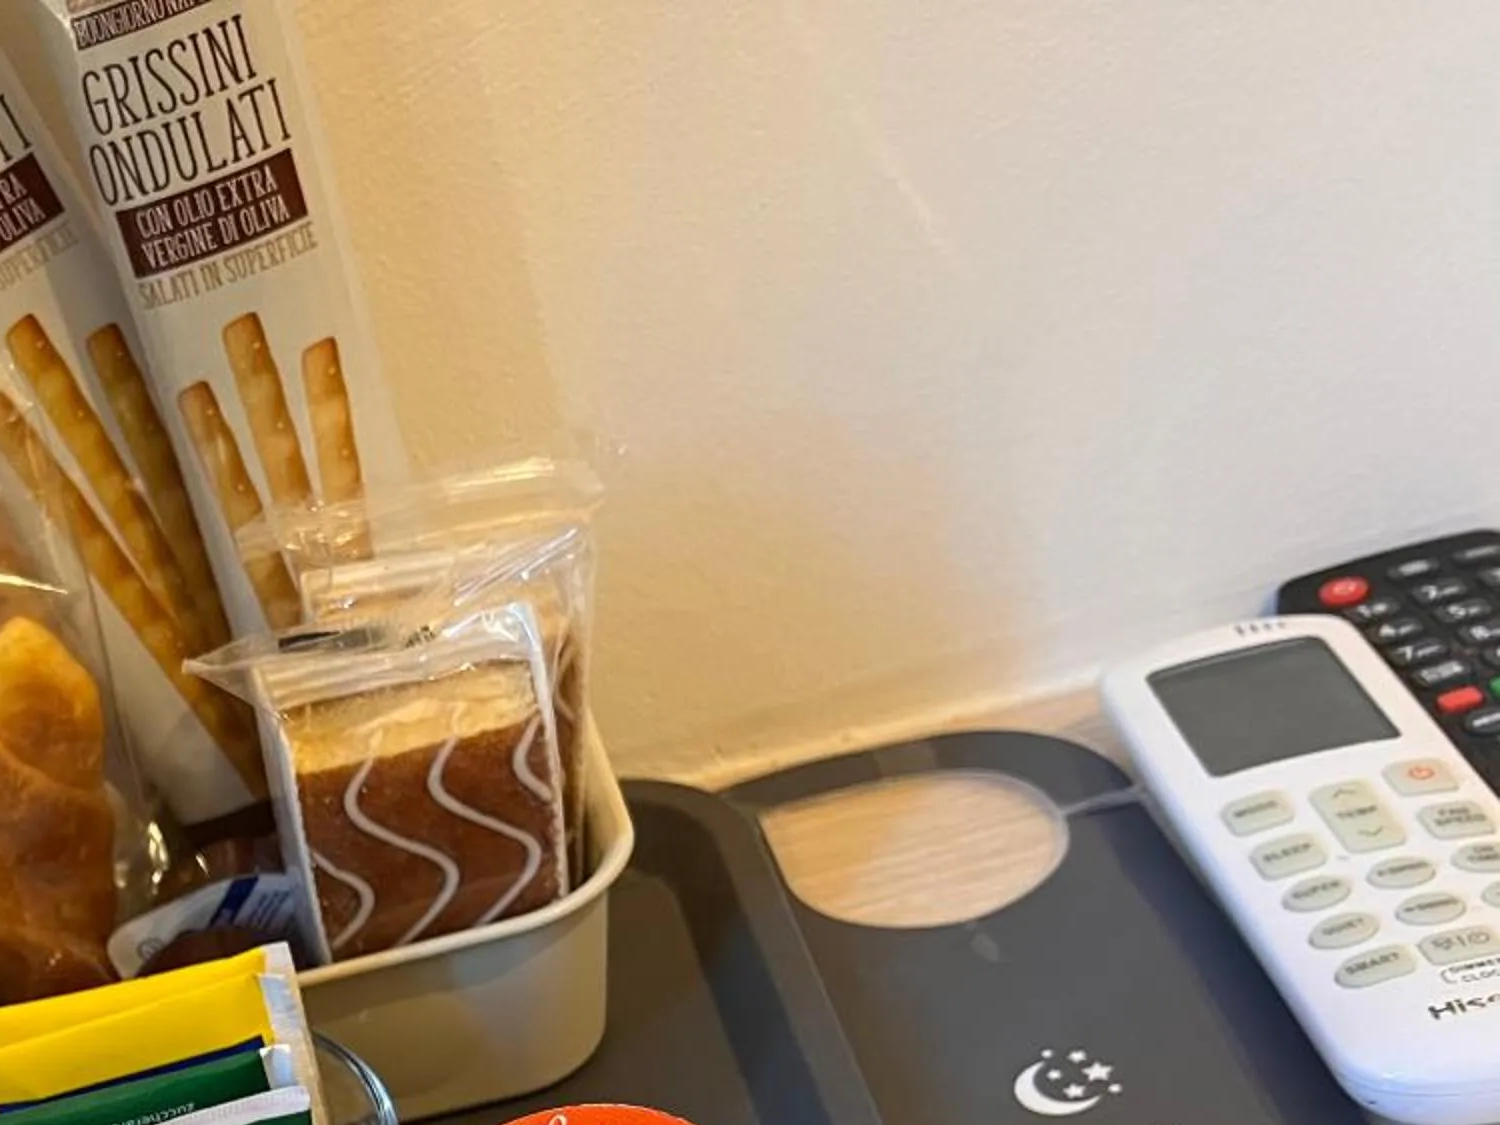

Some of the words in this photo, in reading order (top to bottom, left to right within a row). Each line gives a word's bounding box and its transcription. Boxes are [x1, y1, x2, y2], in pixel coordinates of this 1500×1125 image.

[82, 14, 257, 135] GRISSINI
[90, 78, 291, 205] ONDULATI
[136, 203, 173, 239] CON
[173, 190, 215, 226] OLIO
[215, 164, 278, 210] EXTRA
[141, 223, 218, 269] VERGINE
[218, 214, 240, 245] DI
[239, 195, 291, 236] OLIVA
[138, 270, 200, 309] SALATI
[200, 262, 223, 291] IN
[222, 221, 318, 283] SUPERFICIE
[1345, 952, 1399, 975] SMART
